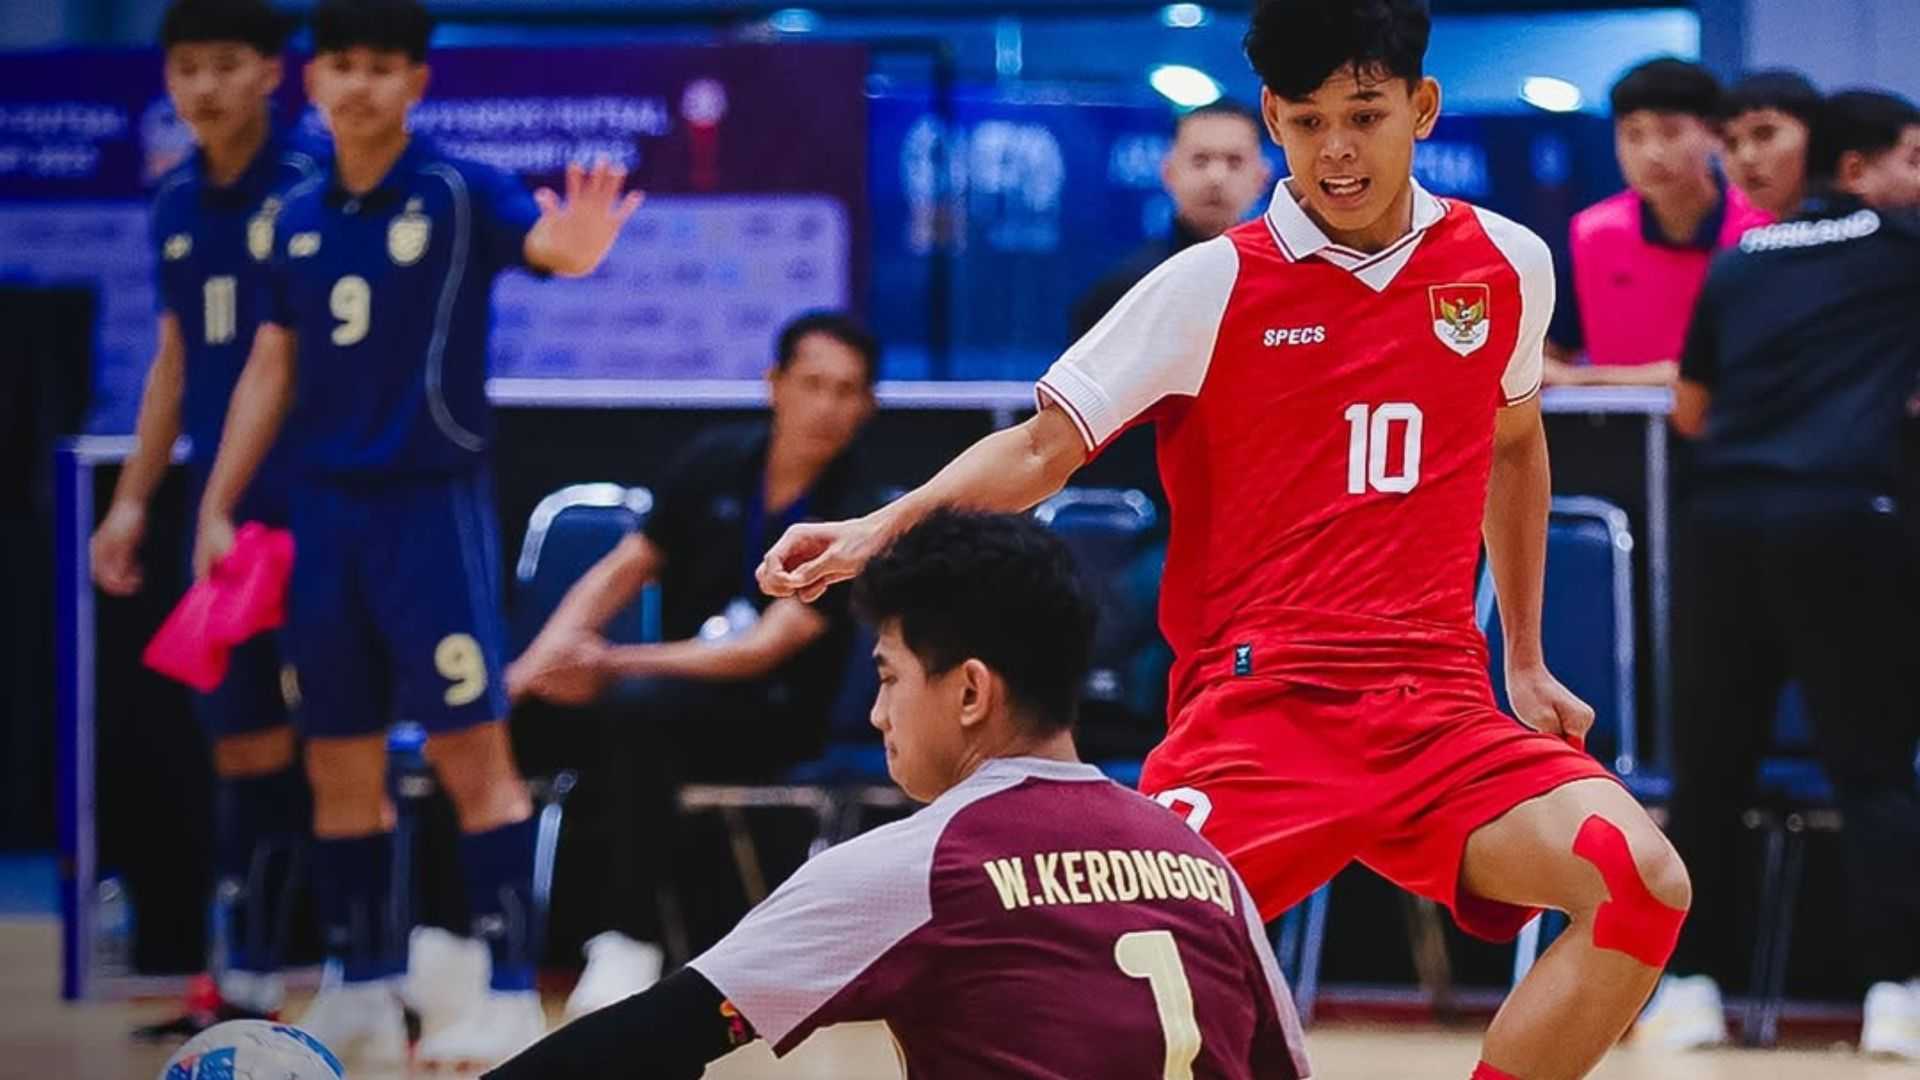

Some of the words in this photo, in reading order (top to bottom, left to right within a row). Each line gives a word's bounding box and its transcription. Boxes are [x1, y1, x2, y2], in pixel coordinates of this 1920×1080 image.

[203, 275, 237, 345] 11
[329, 274, 371, 346] 9
[1263, 326, 1326, 346] SPECS
[1344, 402, 1424, 494] 10
[434, 632, 488, 706] 9
[1114, 929, 1201, 1080] 1
